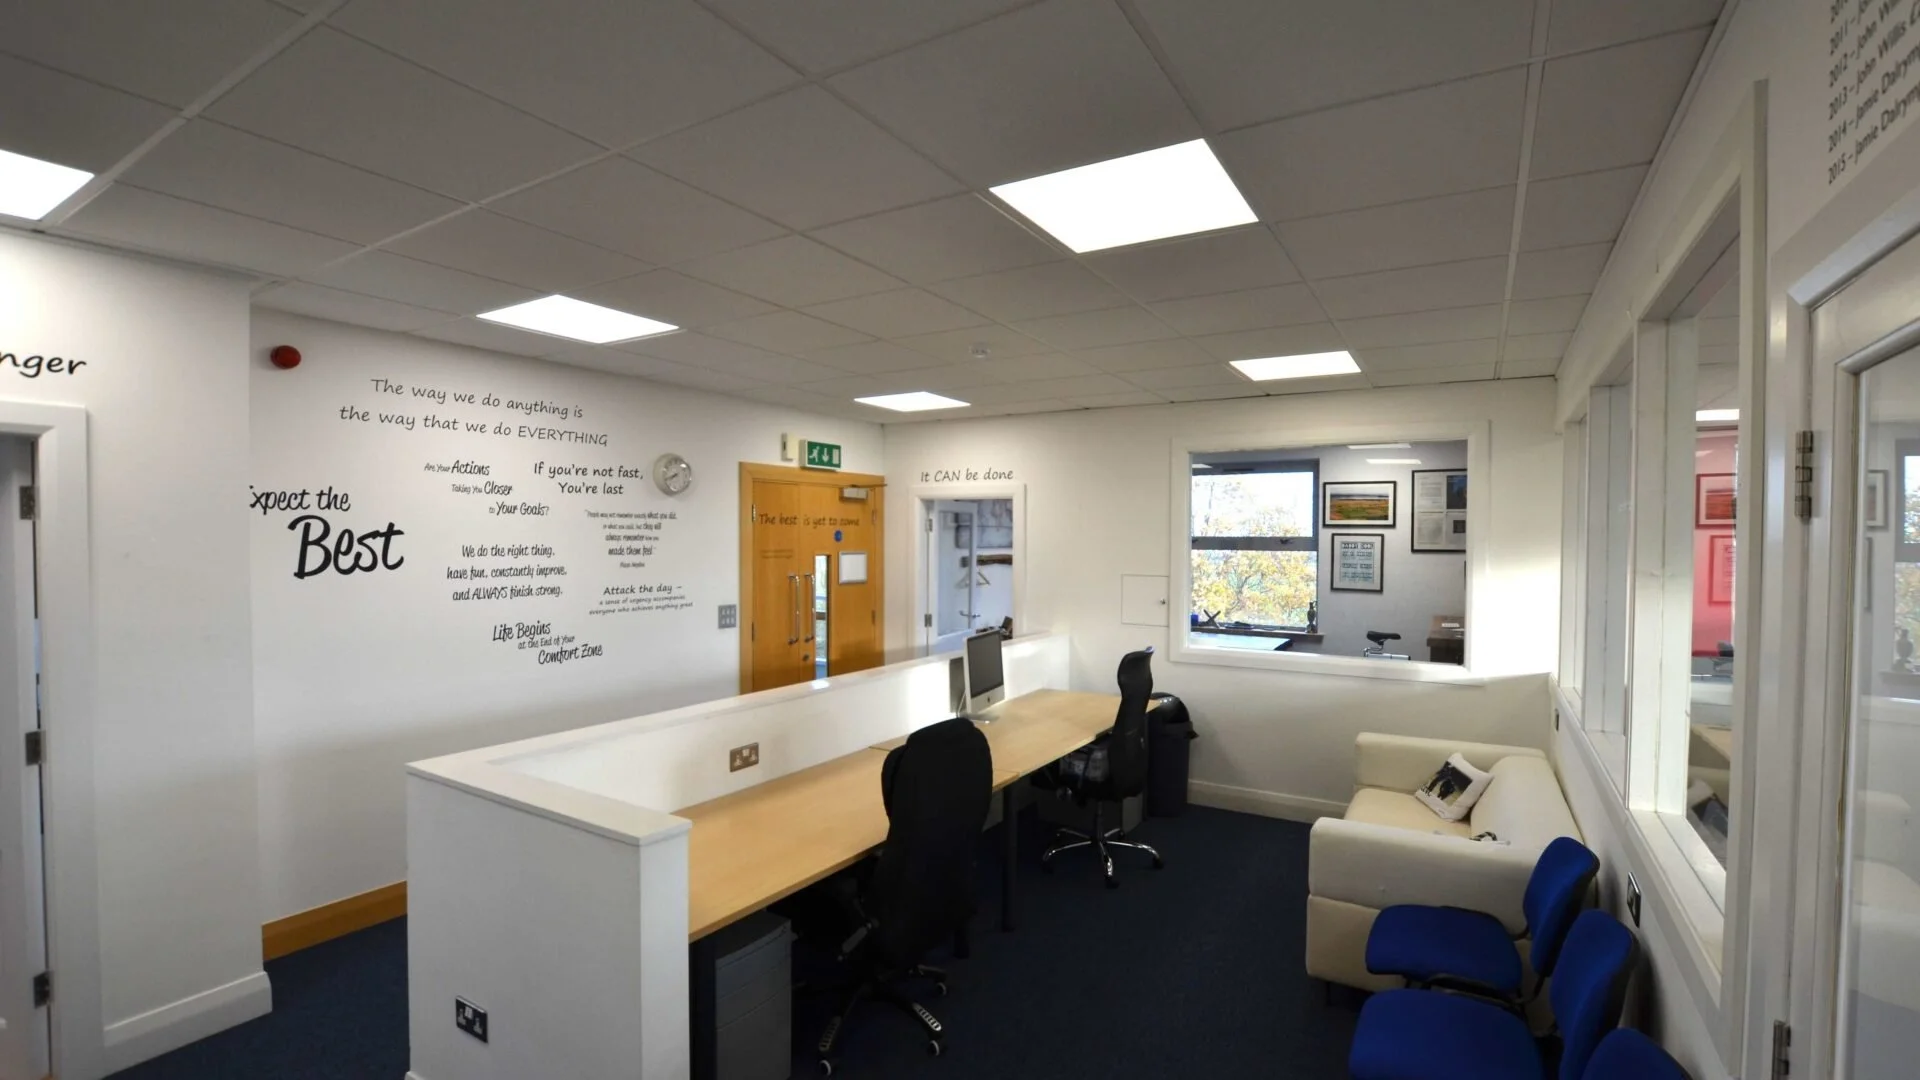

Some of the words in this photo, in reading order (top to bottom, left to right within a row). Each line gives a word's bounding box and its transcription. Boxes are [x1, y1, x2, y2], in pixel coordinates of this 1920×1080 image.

[1829, 52, 1848, 88] 2012
[1856, 20, 1877, 60] John
[1829, 86, 1848, 120] 2013
[1856, 57, 1876, 95] John
[1828, 119, 1847, 153] 2014
[1855, 88, 1879, 129] Jamie
[1828, 152, 1846, 186] 2015
[1854, 124, 1879, 165] Jamie
[370, 378, 404, 395] The
[411, 386, 446, 405] way
[453, 392, 475, 404] we
[481, 393, 501, 407] do
[506, 399, 568, 420] anything
[573, 404, 583, 418] is
[339, 405, 371, 422] the
[378, 412, 416, 431] way
[423, 414, 460, 431] that
[465, 421, 487, 434] we
[493, 421, 512, 436] do
[518, 425, 608, 447] EVERYTHING
[424, 462, 436, 472] Are
[436, 463, 451, 473] Your
[451, 459, 491, 476] Actions
[534, 461, 544, 475] If
[548, 463, 588, 479] you're
[592, 466, 614, 478] not
[617, 465, 644, 480] fast,
[920, 471, 930, 482] It
[934, 470, 961, 482] CAN
[965, 468, 978, 480] be
[983, 467, 1014, 480] done
[451, 484, 471, 495] Taking
[472, 484, 483, 494] You
[483, 480, 513, 496] Closer
[558, 482, 598, 494] You're
[602, 482, 624, 495] last
[249, 485, 311, 516] xpect
[315, 486, 351, 512] the
[488, 506, 496, 514] to
[496, 501, 518, 516] Your
[519, 502, 550, 516] Goals?
[759, 513, 776, 525] The
[779, 513, 798, 526] best
[803, 514, 810, 526] is
[813, 516, 826, 529] yet
[829, 517, 838, 526] to
[840, 518, 860, 526] come
[287, 514, 405, 580] Best
[461, 545, 475, 558] We
[477, 545, 488, 557] do
[490, 544, 506, 557] the
[507, 544, 529, 559] right
[608, 544, 625, 555] made
[626, 544, 641, 555] them
[446, 566, 468, 579] have
[490, 564, 535, 579] constantly
[452, 588, 470, 600] and
[471, 586, 508, 600] ALWAYS
[509, 584, 534, 599] finish
[535, 585, 563, 598] strong.
[603, 585, 636, 595] Attack
[639, 584, 653, 593] the
[656, 583, 673, 594] day
[589, 607, 616, 615] everyone
[655, 602, 678, 610] anything
[492, 623, 514, 642] Life
[515, 620, 551, 640] Begins
[518, 641, 526, 650] at
[527, 639, 539, 648] the
[540, 637, 552, 647] End
[553, 636, 560, 646] of
[561, 635, 575, 645] Your
[538, 647, 579, 665] Comfort
[580, 643, 603, 659] Zone
